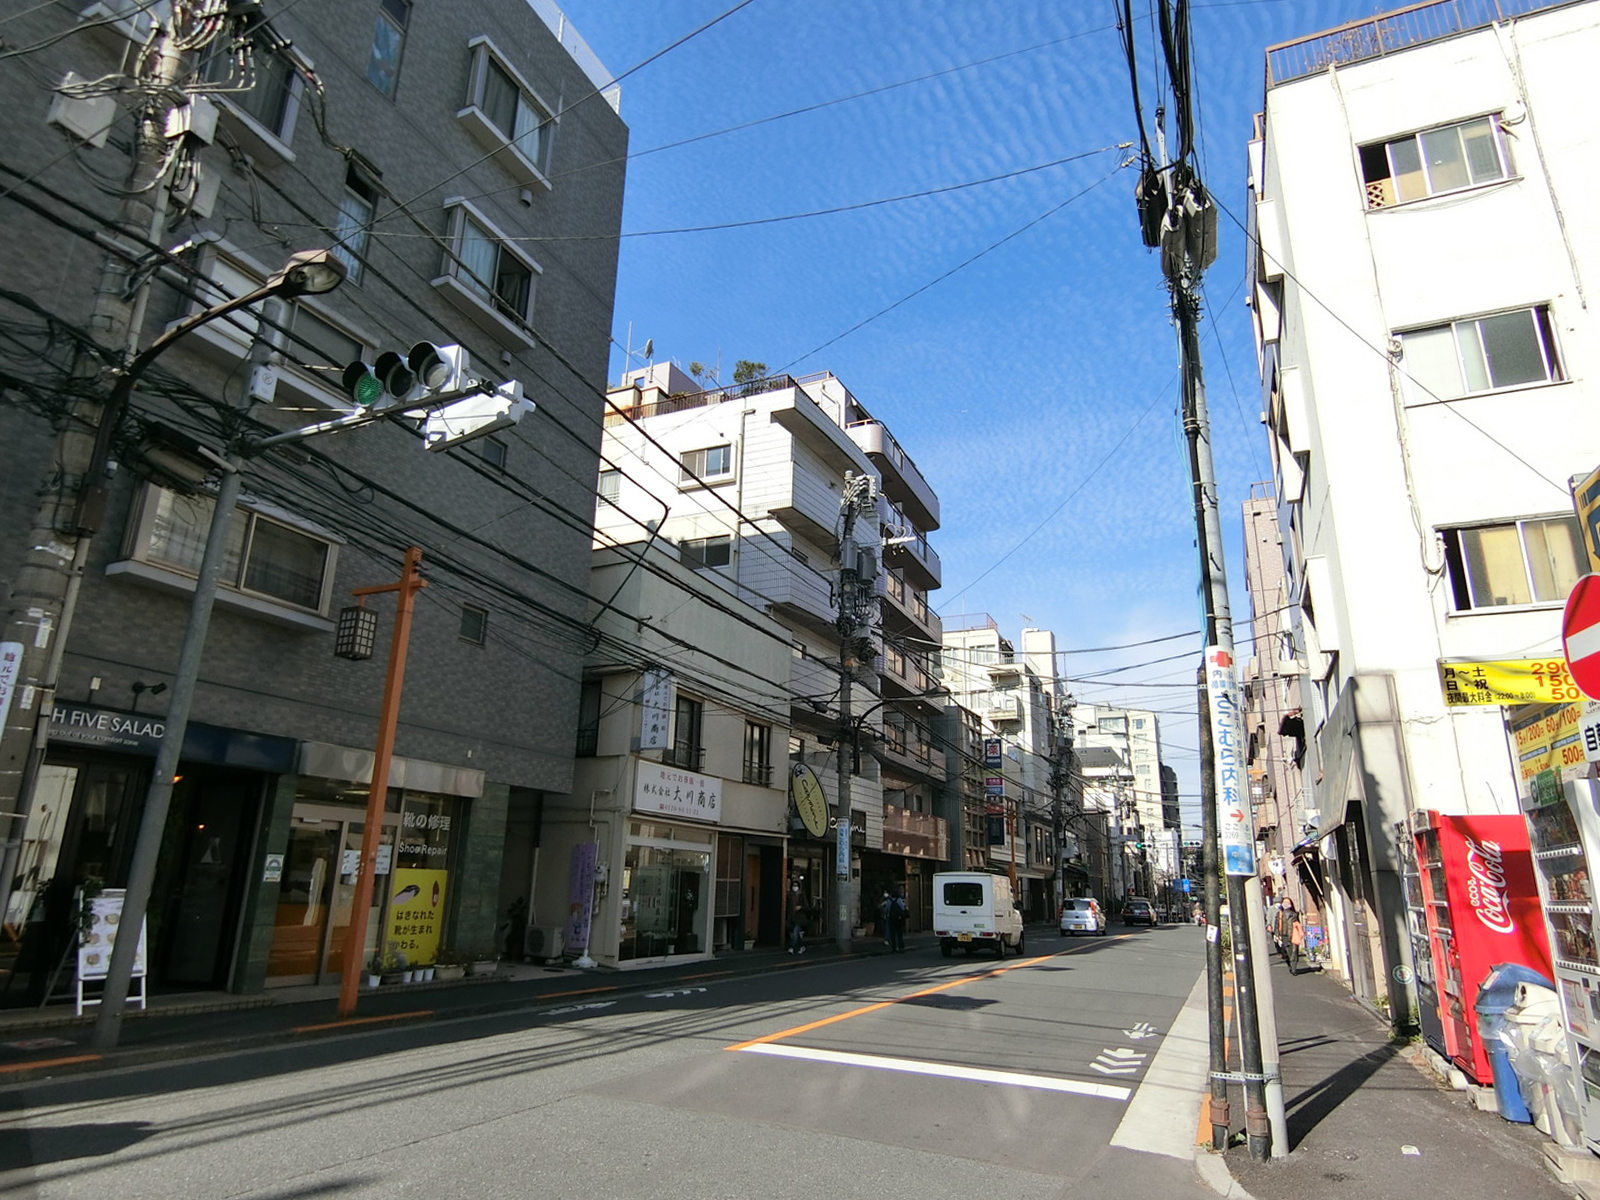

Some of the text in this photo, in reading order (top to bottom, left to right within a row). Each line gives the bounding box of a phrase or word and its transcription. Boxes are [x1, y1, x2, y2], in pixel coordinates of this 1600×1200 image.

[1551, 687, 1587, 700] 50
[70, 711, 109, 730] FIVE
[111, 717, 165, 738] SALAD
[1214, 690, 1242, 806] さこむら内科
[403, 811, 451, 831] 靴の修理
[422, 844, 448, 857] Repair
